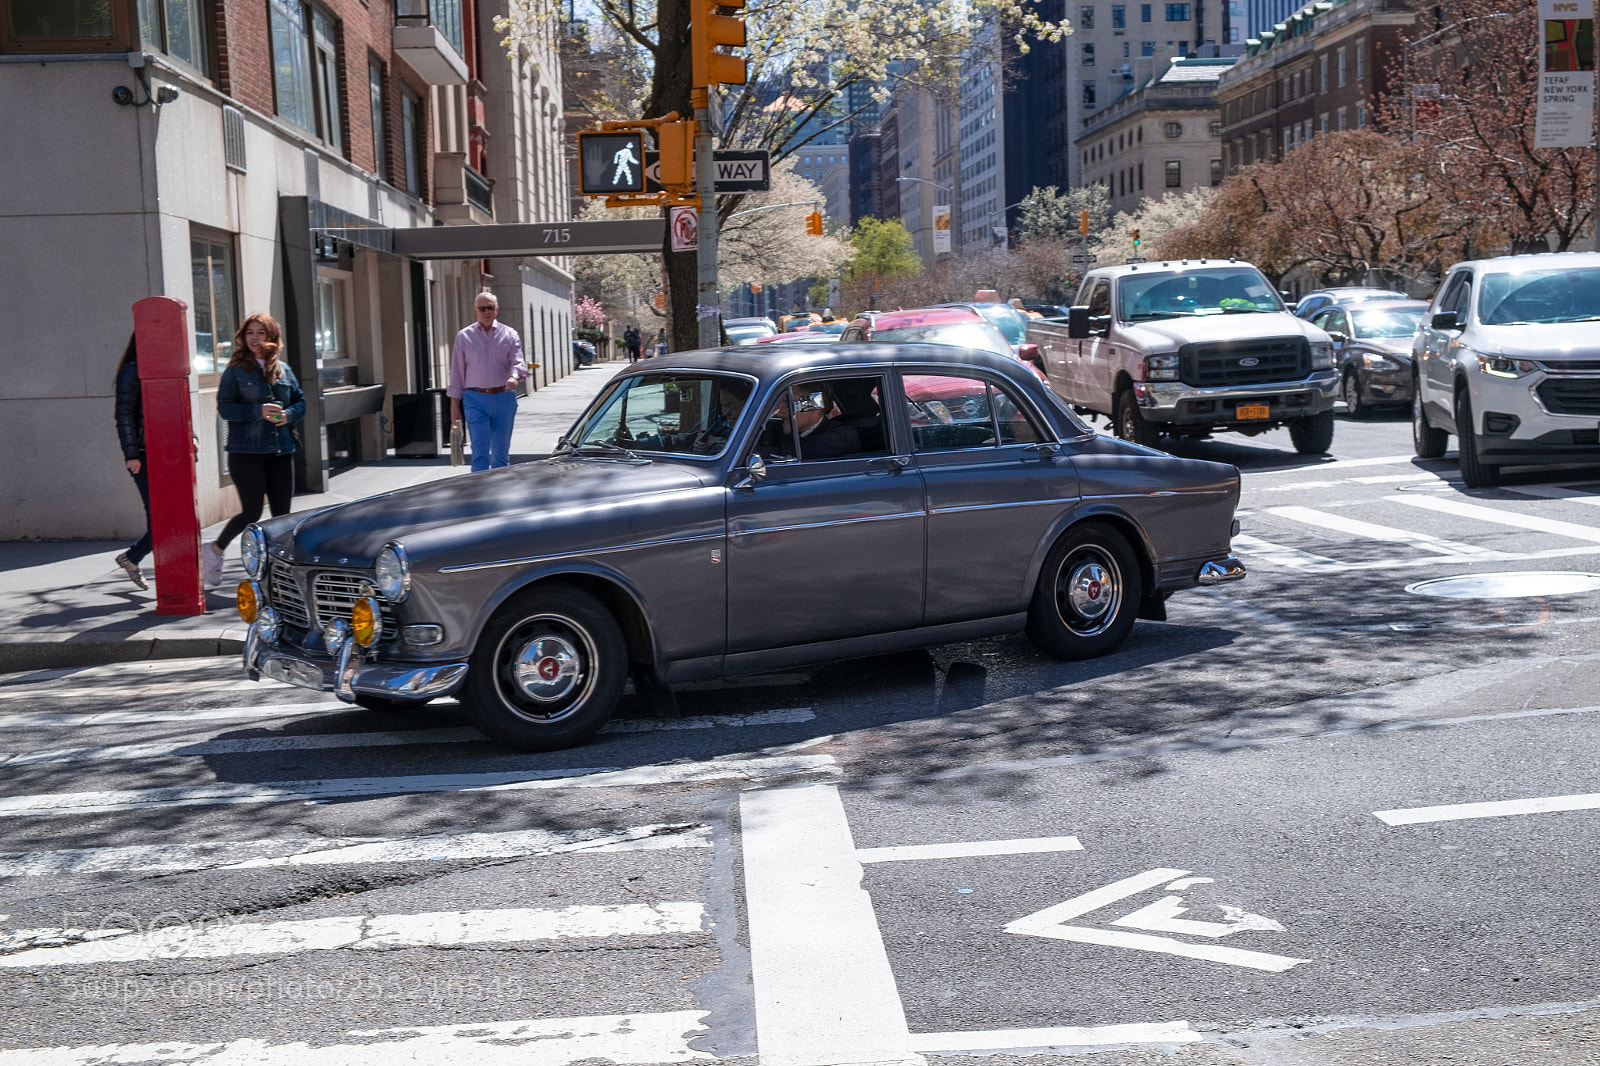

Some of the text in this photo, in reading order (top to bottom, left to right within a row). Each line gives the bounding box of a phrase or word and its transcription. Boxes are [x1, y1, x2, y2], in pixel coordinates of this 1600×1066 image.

[1553, 2, 1579, 12] NYC
[1543, 76, 1570, 85] TEFAF
[1543, 85, 1589, 94] NEW YORK
[1543, 95, 1575, 103] SPRING
[718, 163, 758, 180] WAY
[543, 228, 571, 243] 715
